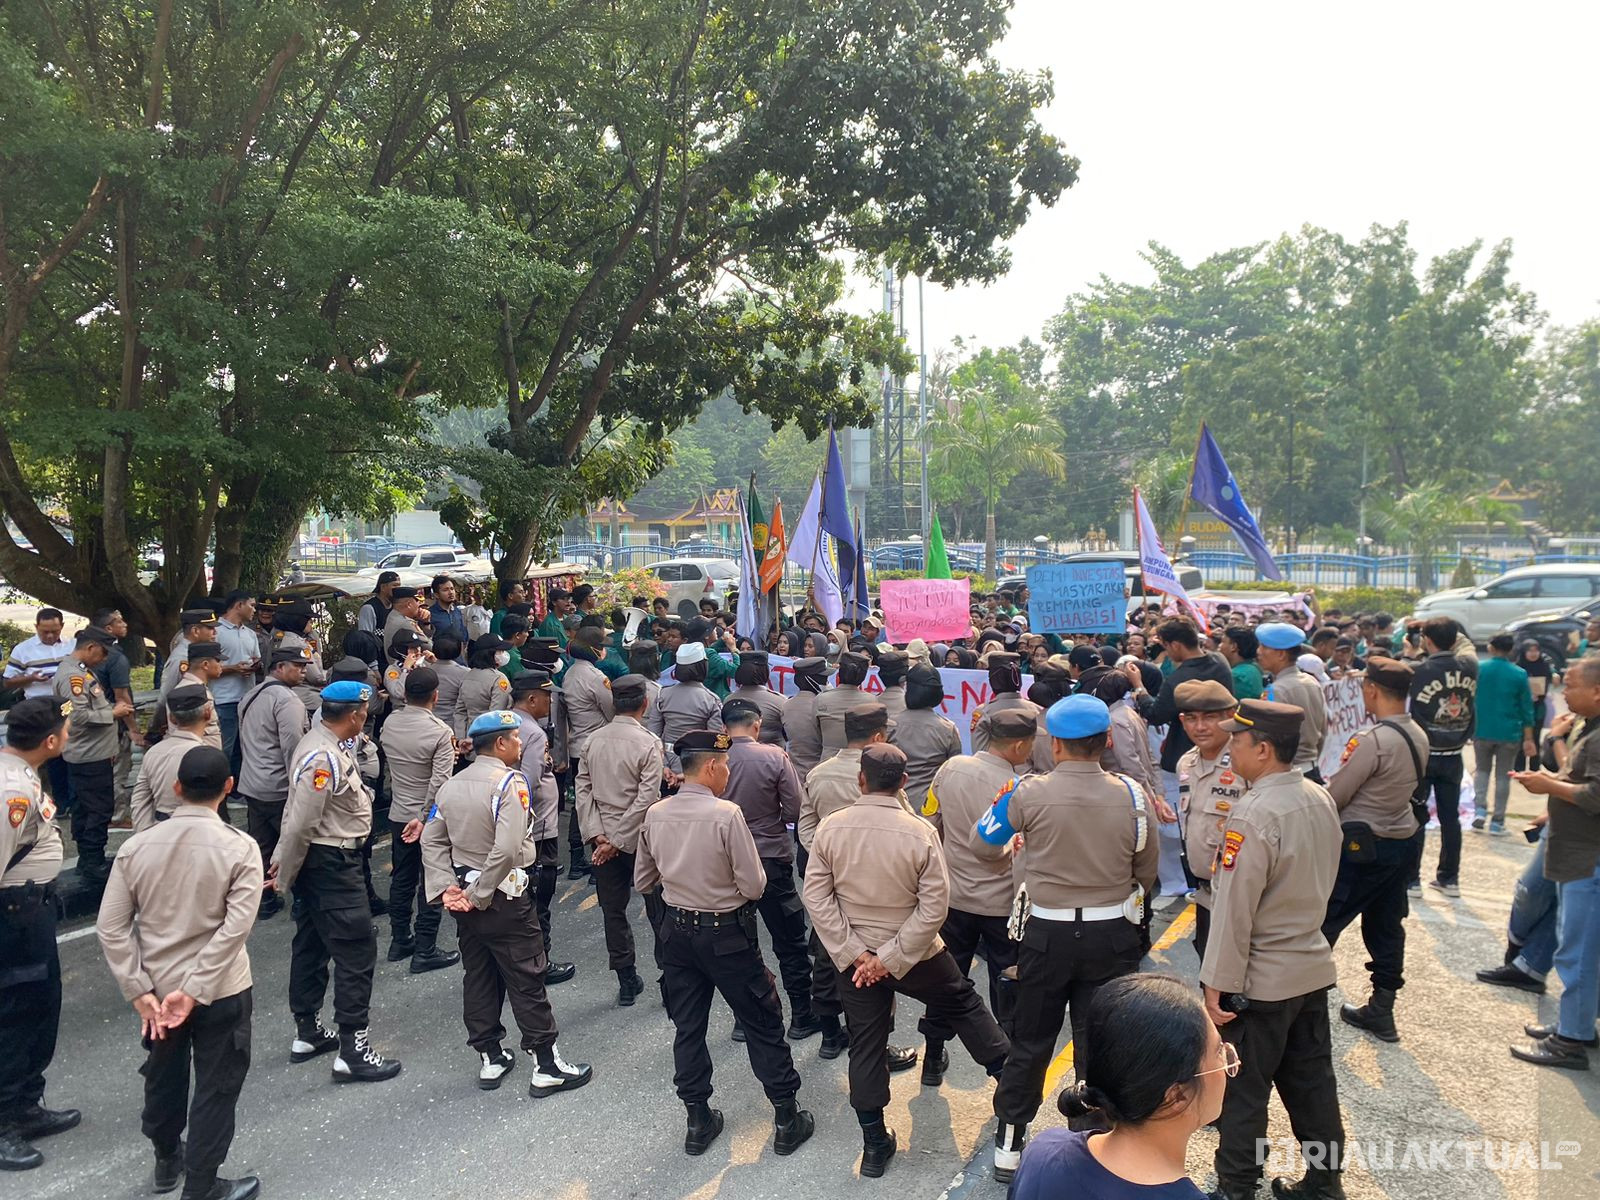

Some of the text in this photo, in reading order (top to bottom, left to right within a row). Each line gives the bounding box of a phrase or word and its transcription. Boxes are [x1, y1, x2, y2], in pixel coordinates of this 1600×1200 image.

[1034, 568, 1066, 583] DEMI
[1052, 582, 1125, 598] MASYARAKAT
[1037, 598, 1101, 613] REMPANG
[1211, 786, 1240, 799] POLRI
